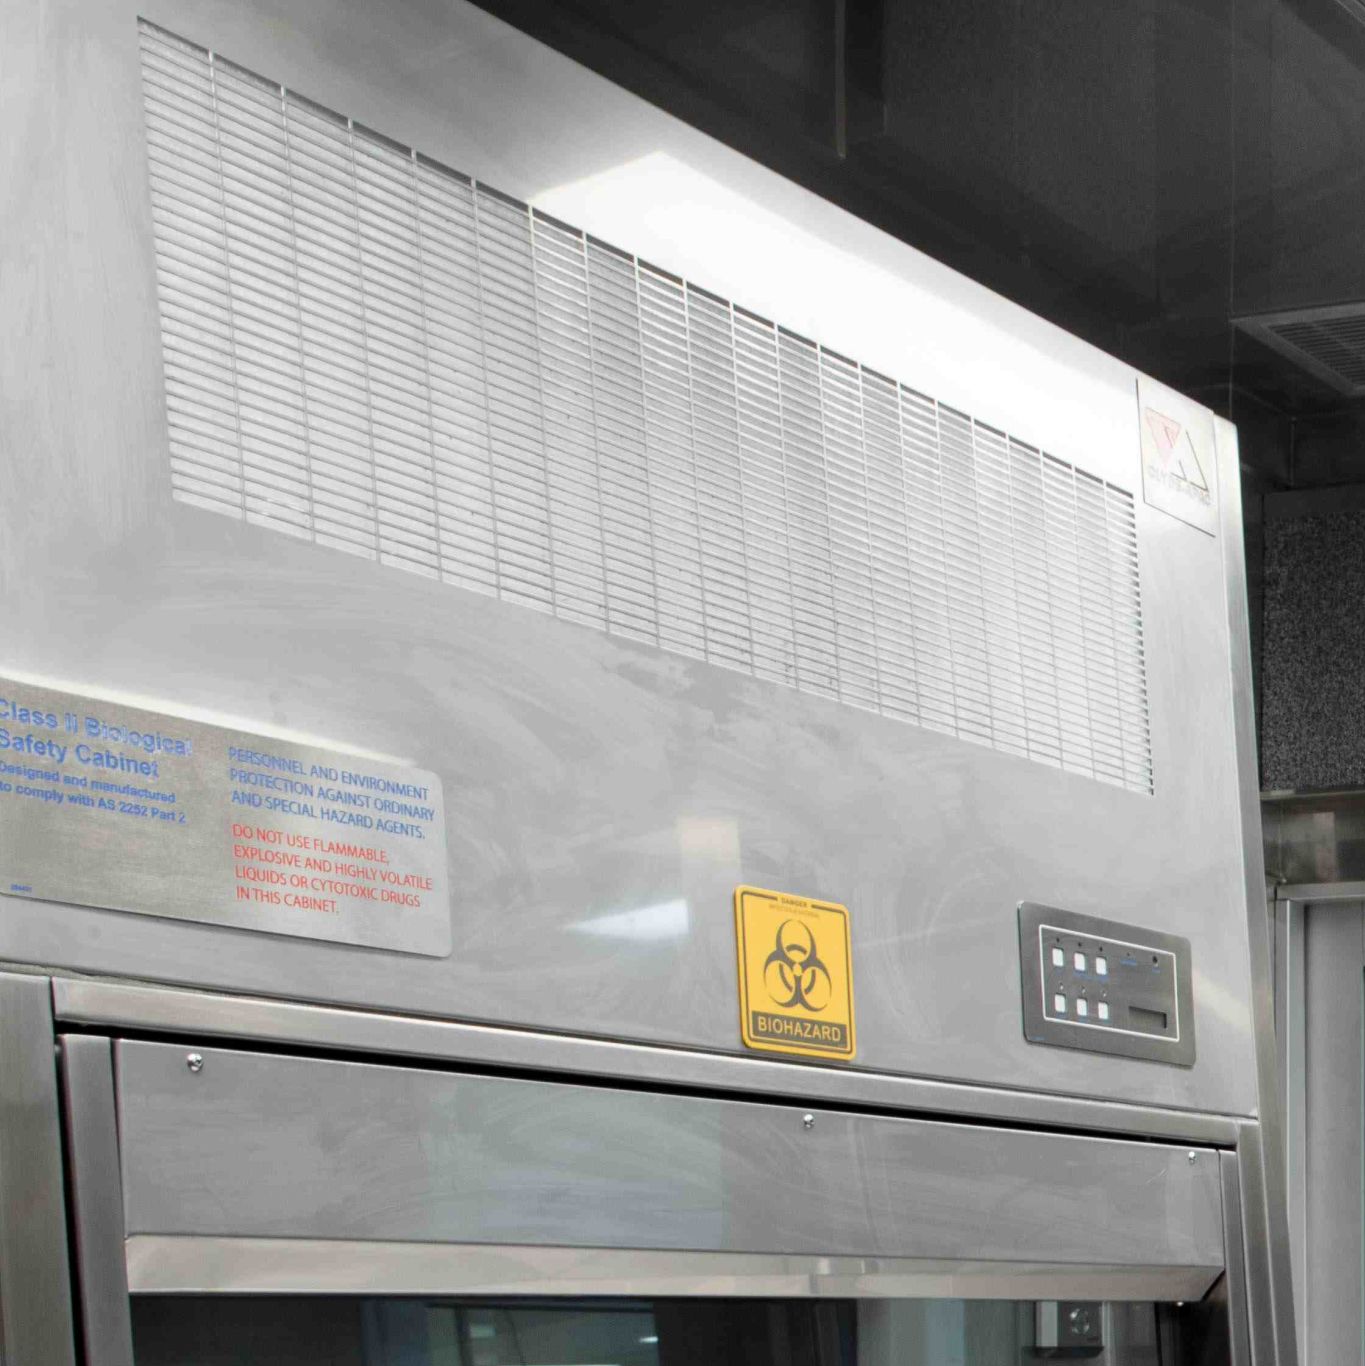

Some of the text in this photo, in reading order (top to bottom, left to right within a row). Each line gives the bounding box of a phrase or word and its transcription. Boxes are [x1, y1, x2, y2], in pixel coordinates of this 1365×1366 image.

[0, 699, 58, 728] Class
[84, 716, 192, 756] Biological
[0, 728, 160, 778] Safety Cabinet
[228, 746, 430, 801] PERSONNEL AND ENVIRONMENT
[0, 760, 177, 804] Designed and manufactured
[0, 781, 186, 824] to comply with AS 2252 Part 2
[229, 767, 435, 822] PROTECTION AGAINST ORDINARY
[231, 790, 426, 840] AND SPECIAL HAZARD AGENTS.
[232, 824, 389, 866] DO NOT USE FLAMMABLE,
[234, 844, 433, 891] EXPLOSIVE AND HIGHLY VOLATILE
[235, 865, 421, 908] LIQUIDS OR CYTOTOXIC DRUGS
[236, 885, 339, 915] IN THIS CABINET.
[757, 1015, 841, 1042] BIOHAZARD
